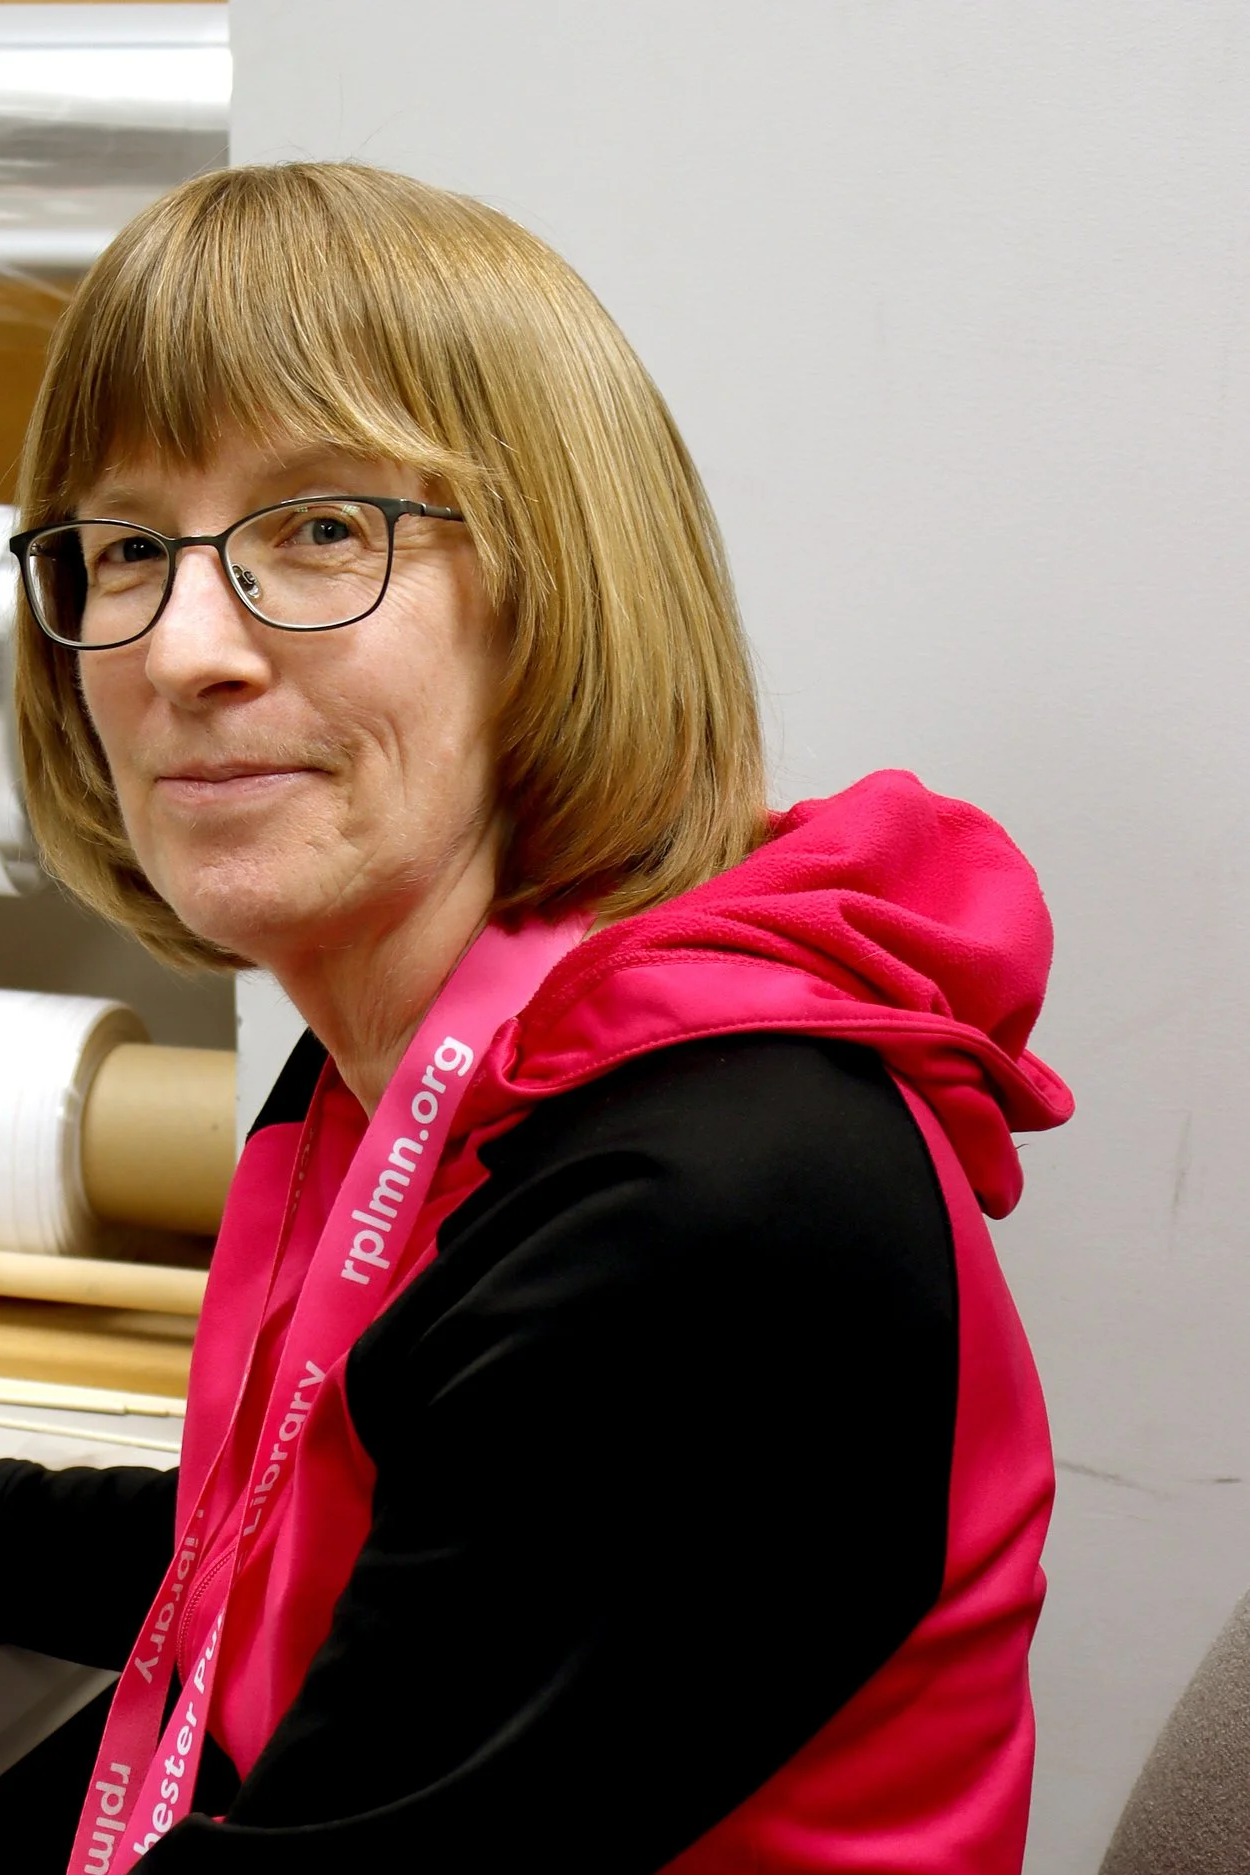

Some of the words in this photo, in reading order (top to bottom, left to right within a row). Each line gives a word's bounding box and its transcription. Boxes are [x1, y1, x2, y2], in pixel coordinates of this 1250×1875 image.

[340, 1036, 474, 1285] rplmn.org
[243, 1360, 327, 1537] Library
[134, 1509, 204, 1684] ibrary
[133, 1701, 198, 1857] hester
